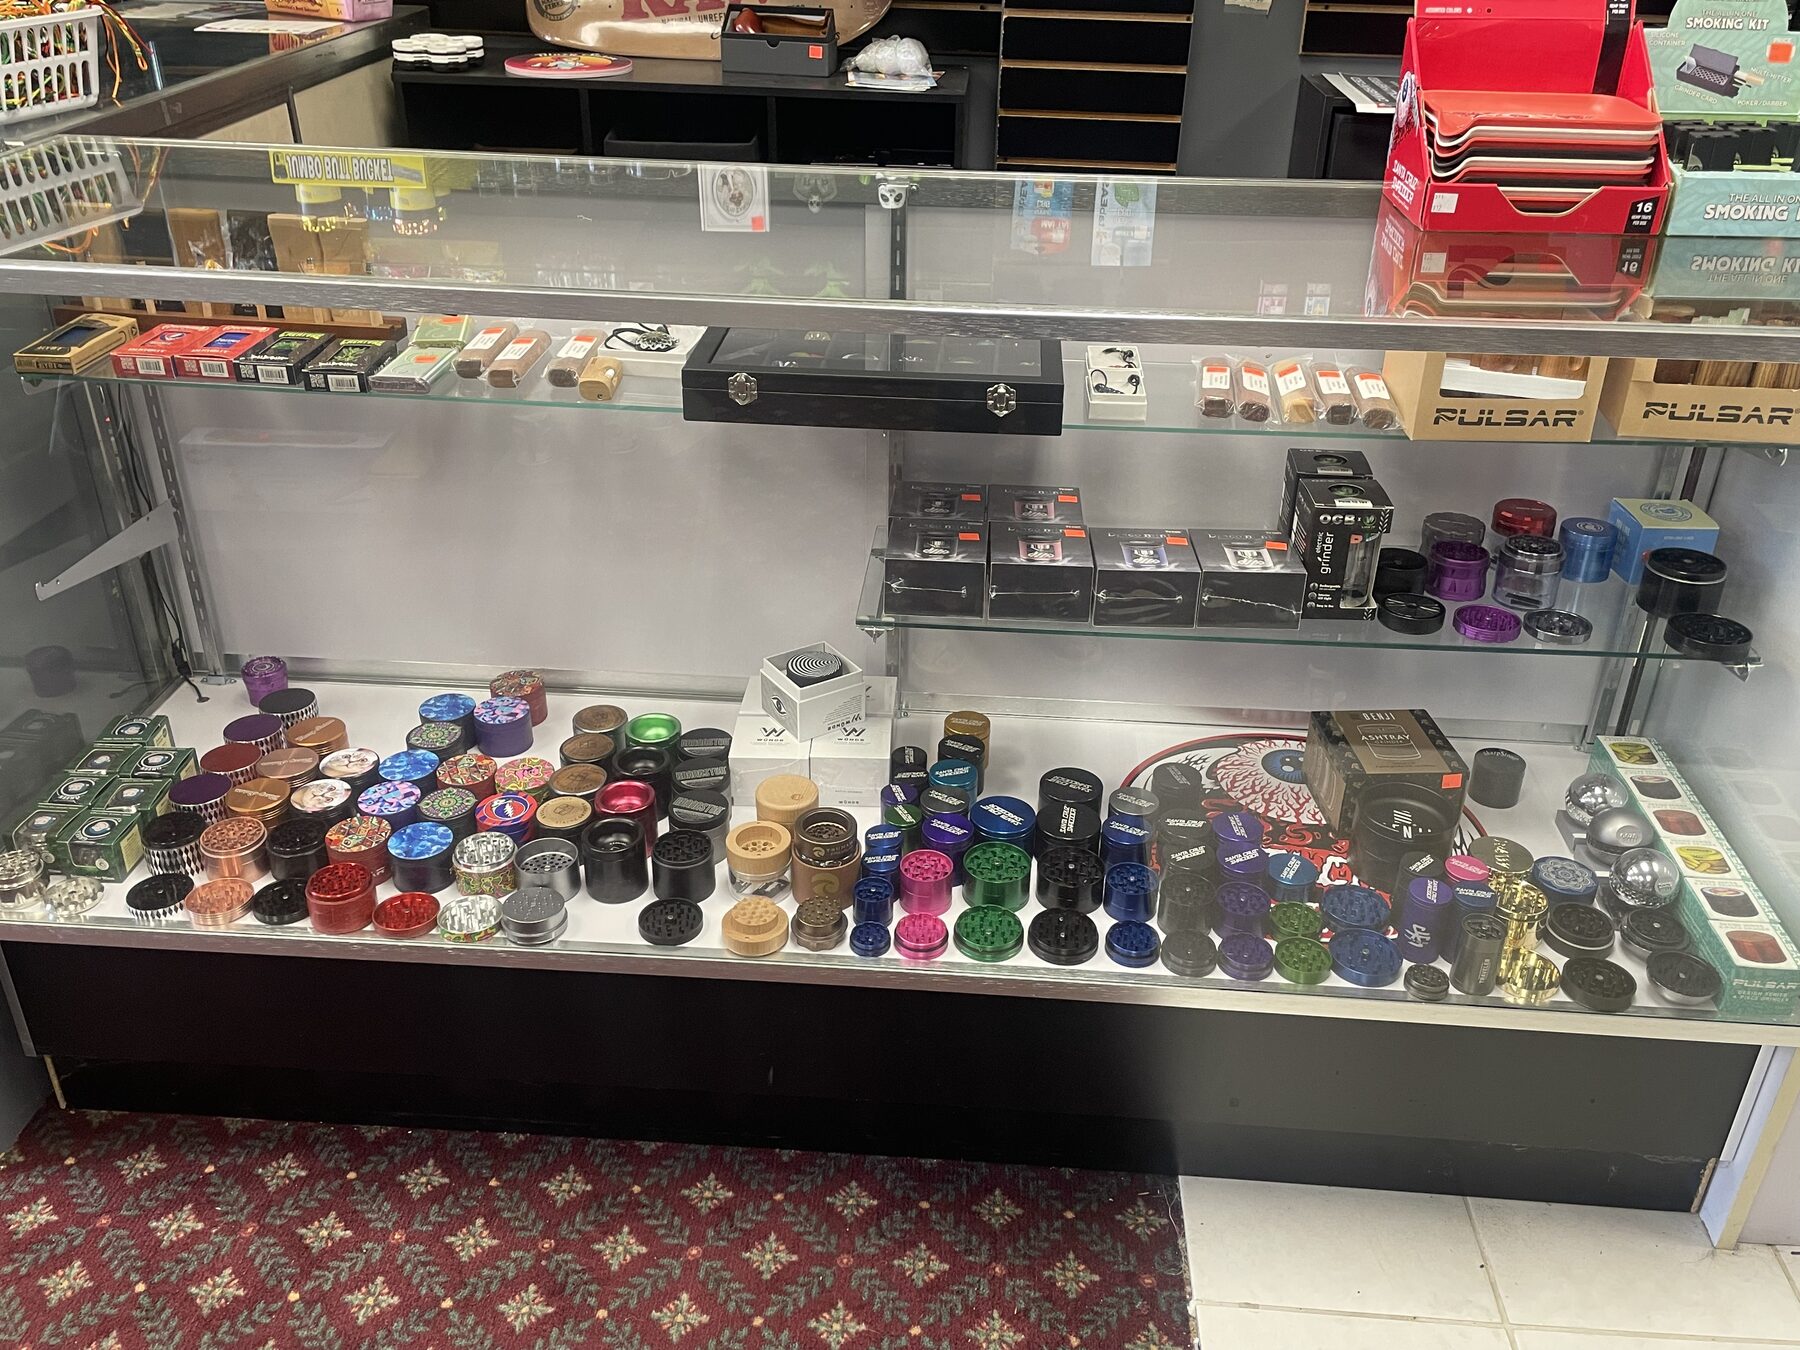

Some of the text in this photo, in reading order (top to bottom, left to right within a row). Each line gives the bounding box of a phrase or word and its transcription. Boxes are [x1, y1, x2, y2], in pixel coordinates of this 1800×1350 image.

[1685, 17, 1770, 31] SMOKING KIT
[1674, 85, 1718, 104] GRINDER CARD
[1636, 202, 1653, 213] 16
[1729, 193, 1749, 203] THE
[1751, 194, 1771, 204] ALL
[1773, 195, 1785, 204] IN
[1703, 204, 1789, 221] SMOKING
[1433, 408, 1577, 427] PULSAR
[1642, 402, 1795, 425] PULSAR
[1319, 514, 1356, 525] OCB
[1315, 531, 1324, 553] electric
[1318, 532, 1334, 574] grinder
